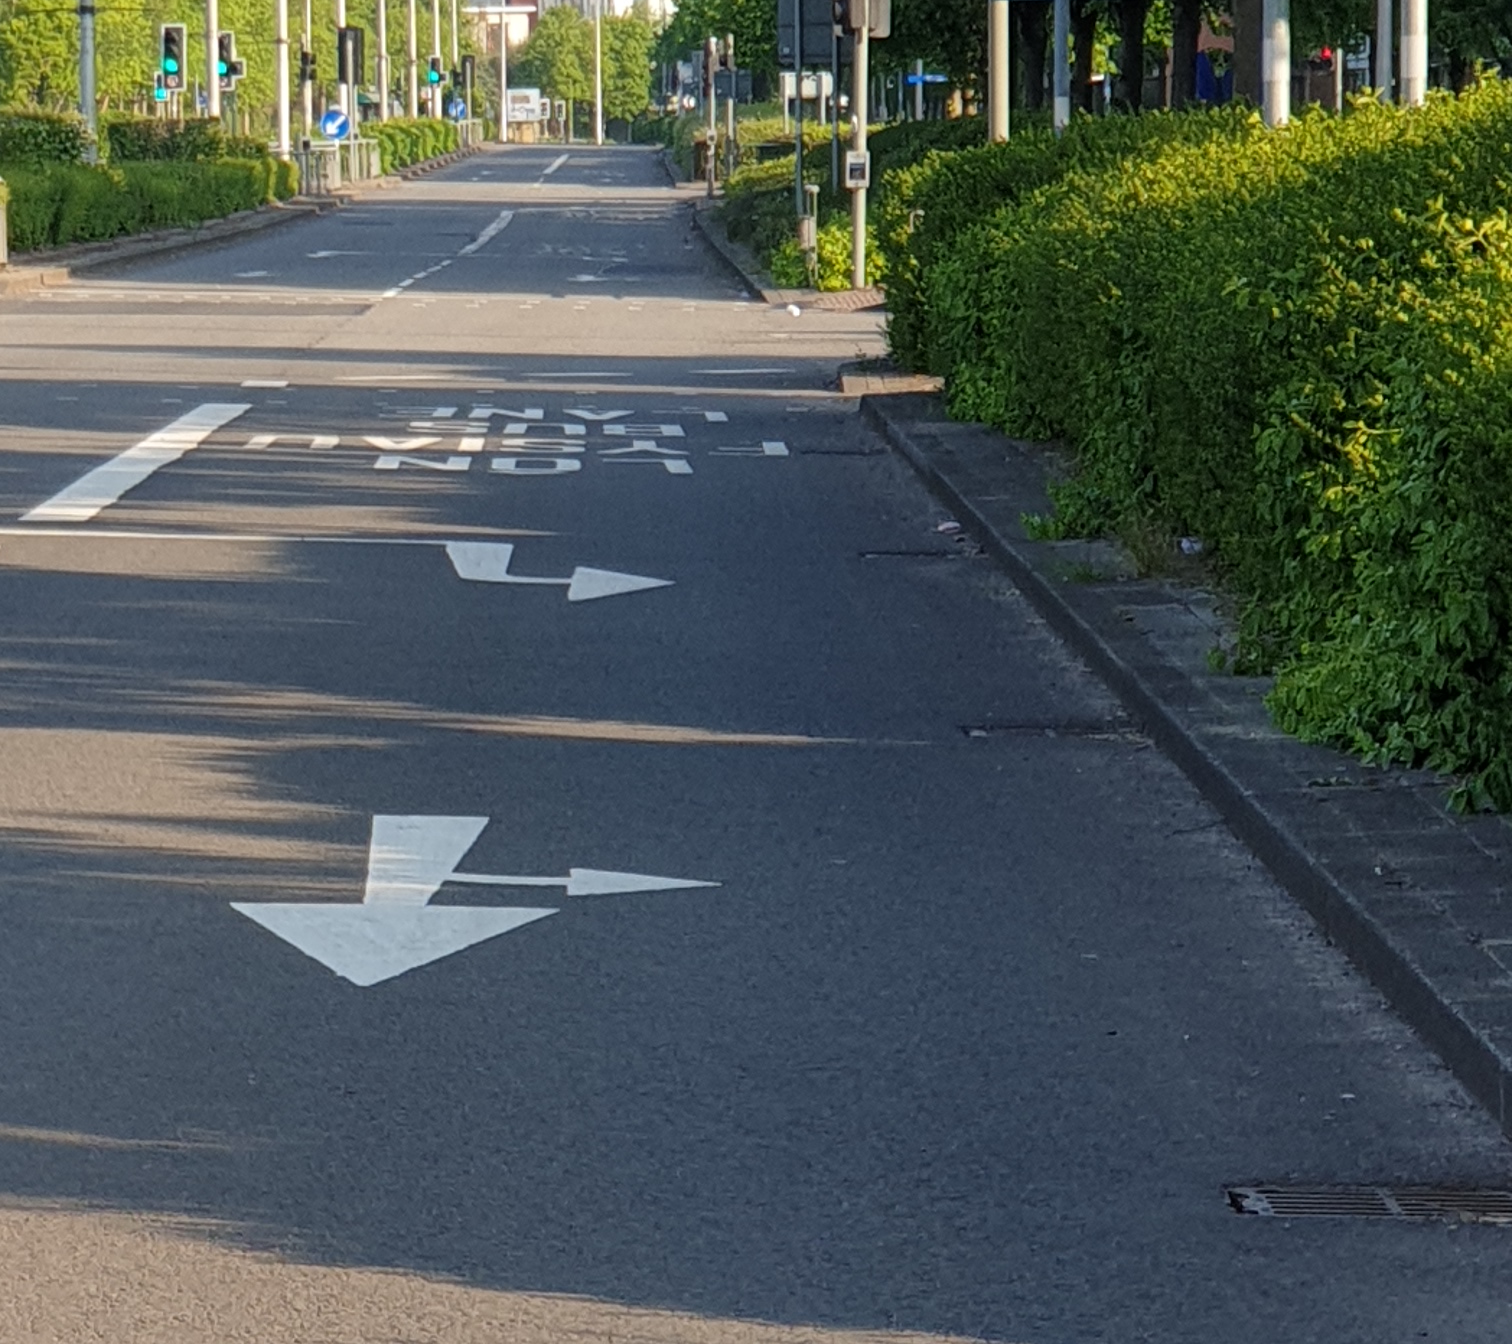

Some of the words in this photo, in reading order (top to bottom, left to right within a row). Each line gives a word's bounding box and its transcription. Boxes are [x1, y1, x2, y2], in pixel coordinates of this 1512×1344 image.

[379, 406, 729, 422] LANE
[407, 423, 686, 436] BUS
[243, 435, 789, 456] FYSIAU
